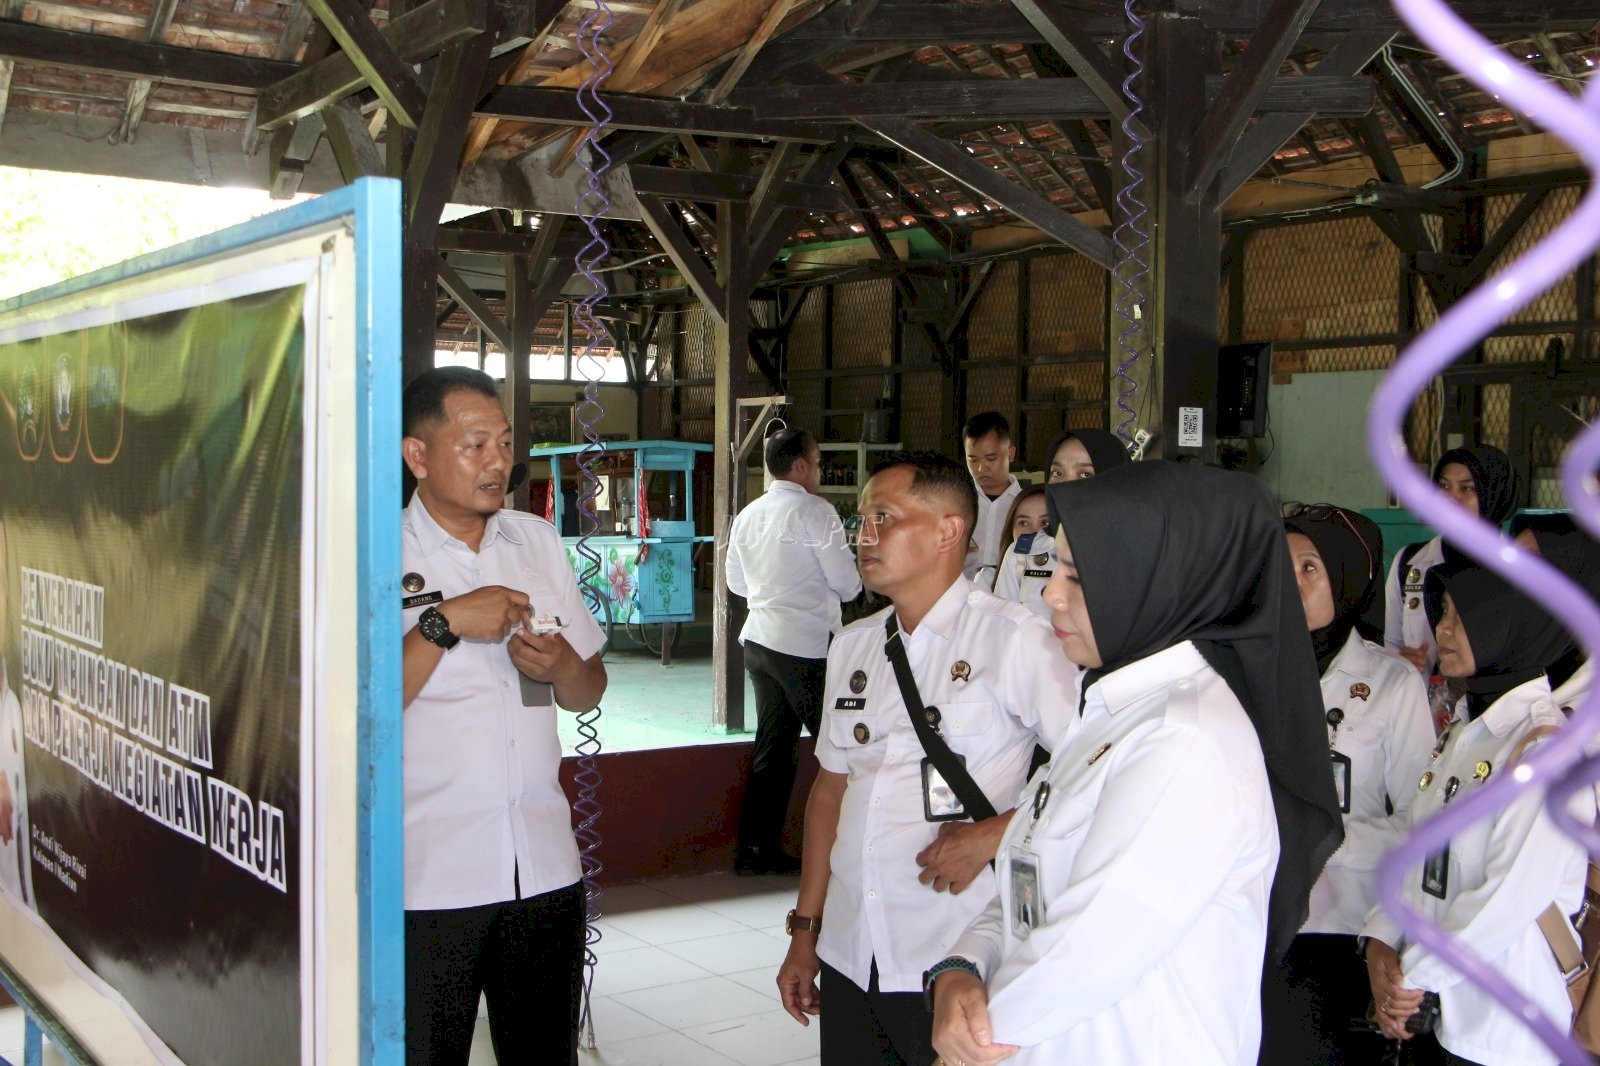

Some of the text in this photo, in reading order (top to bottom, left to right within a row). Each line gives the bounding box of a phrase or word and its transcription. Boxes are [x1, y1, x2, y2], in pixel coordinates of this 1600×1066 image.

[21, 566, 104, 649] PENYERAHAN
[22, 625, 214, 770] BUKU TABUNGAN DAN ATM
[22, 684, 287, 893] BAGI PEKERJA KEGIATAN KERJA
